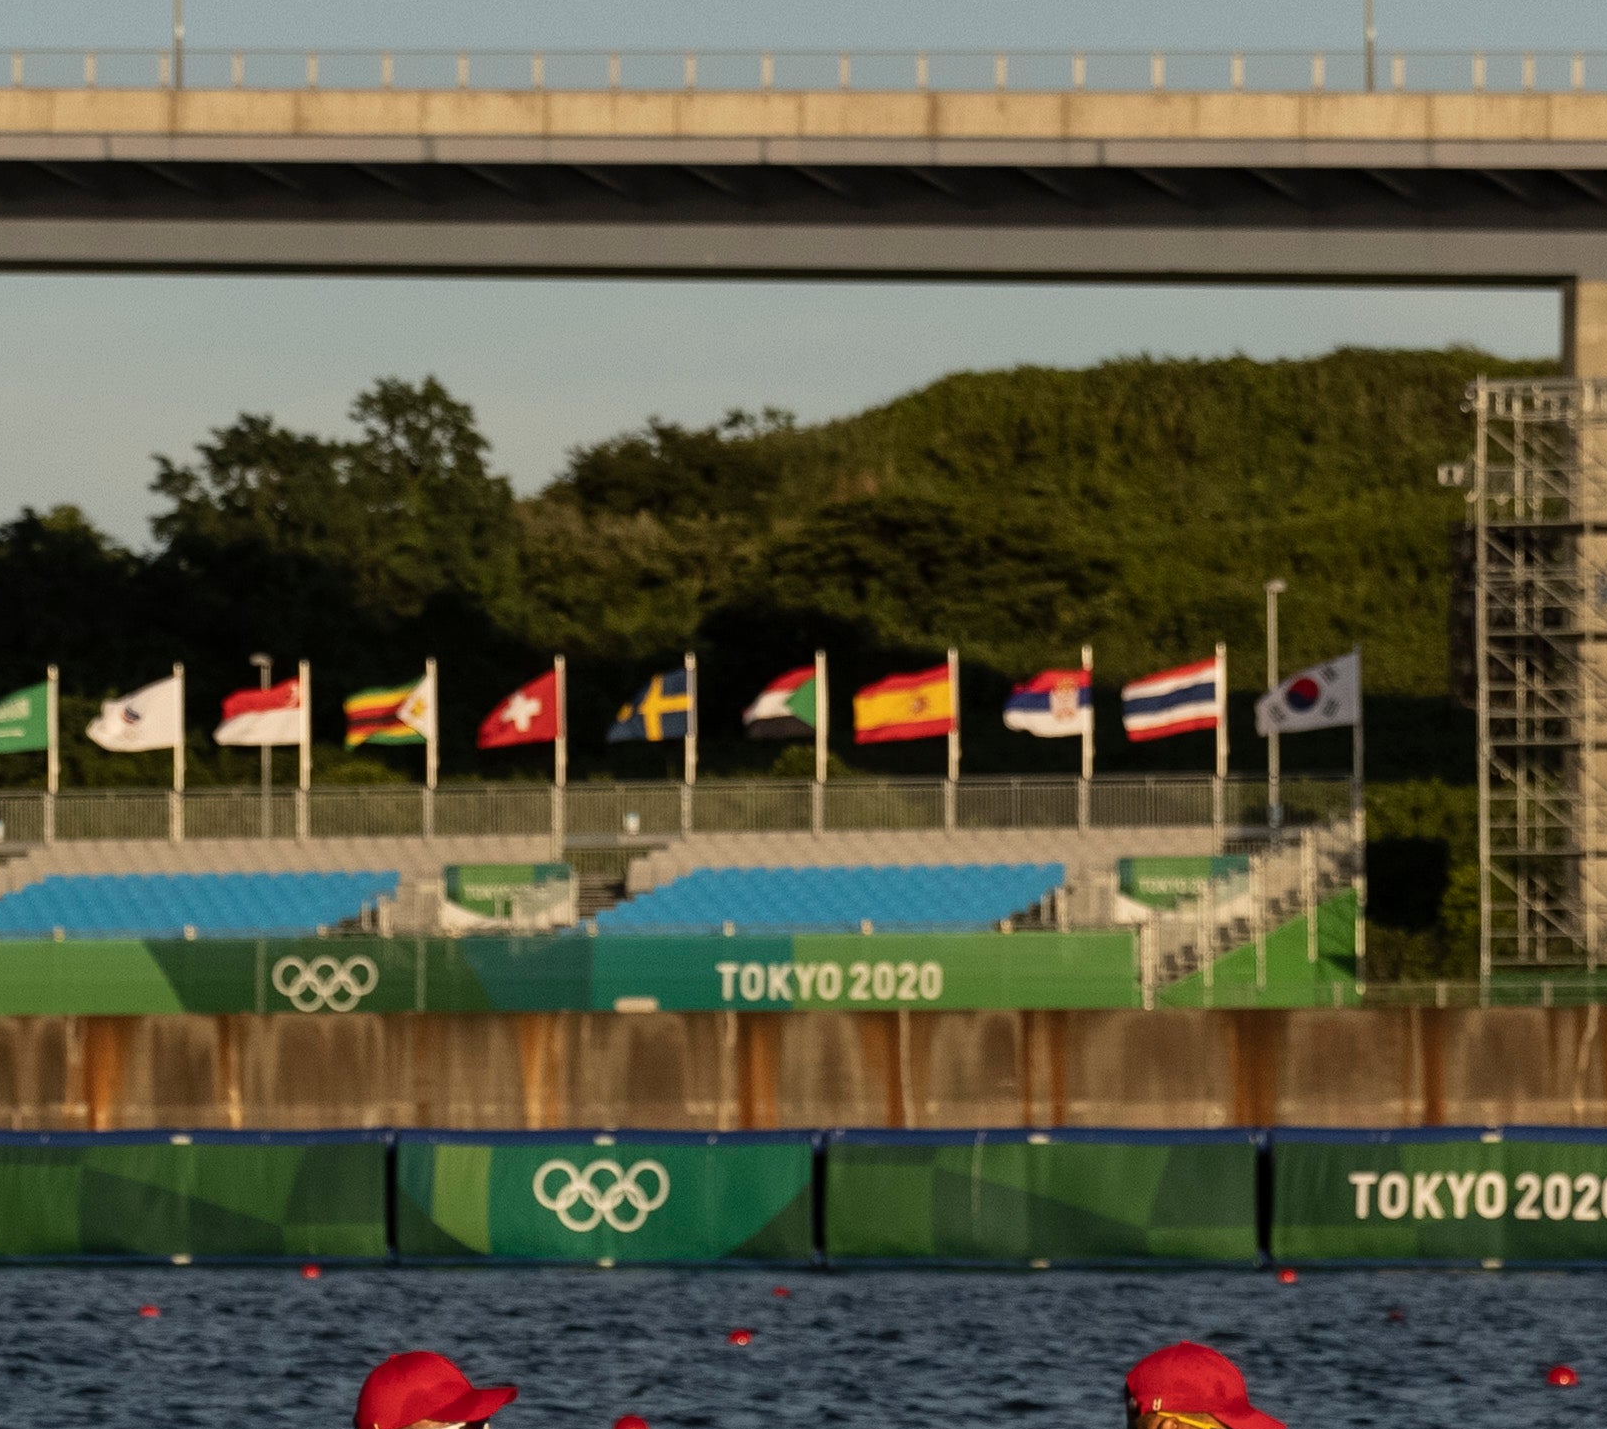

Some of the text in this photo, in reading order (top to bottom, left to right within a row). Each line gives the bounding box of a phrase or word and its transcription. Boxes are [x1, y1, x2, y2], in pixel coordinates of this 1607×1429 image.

[716, 961, 944, 1001] TOKYO 2020
[1348, 1171, 1508, 1220] TOKYO
